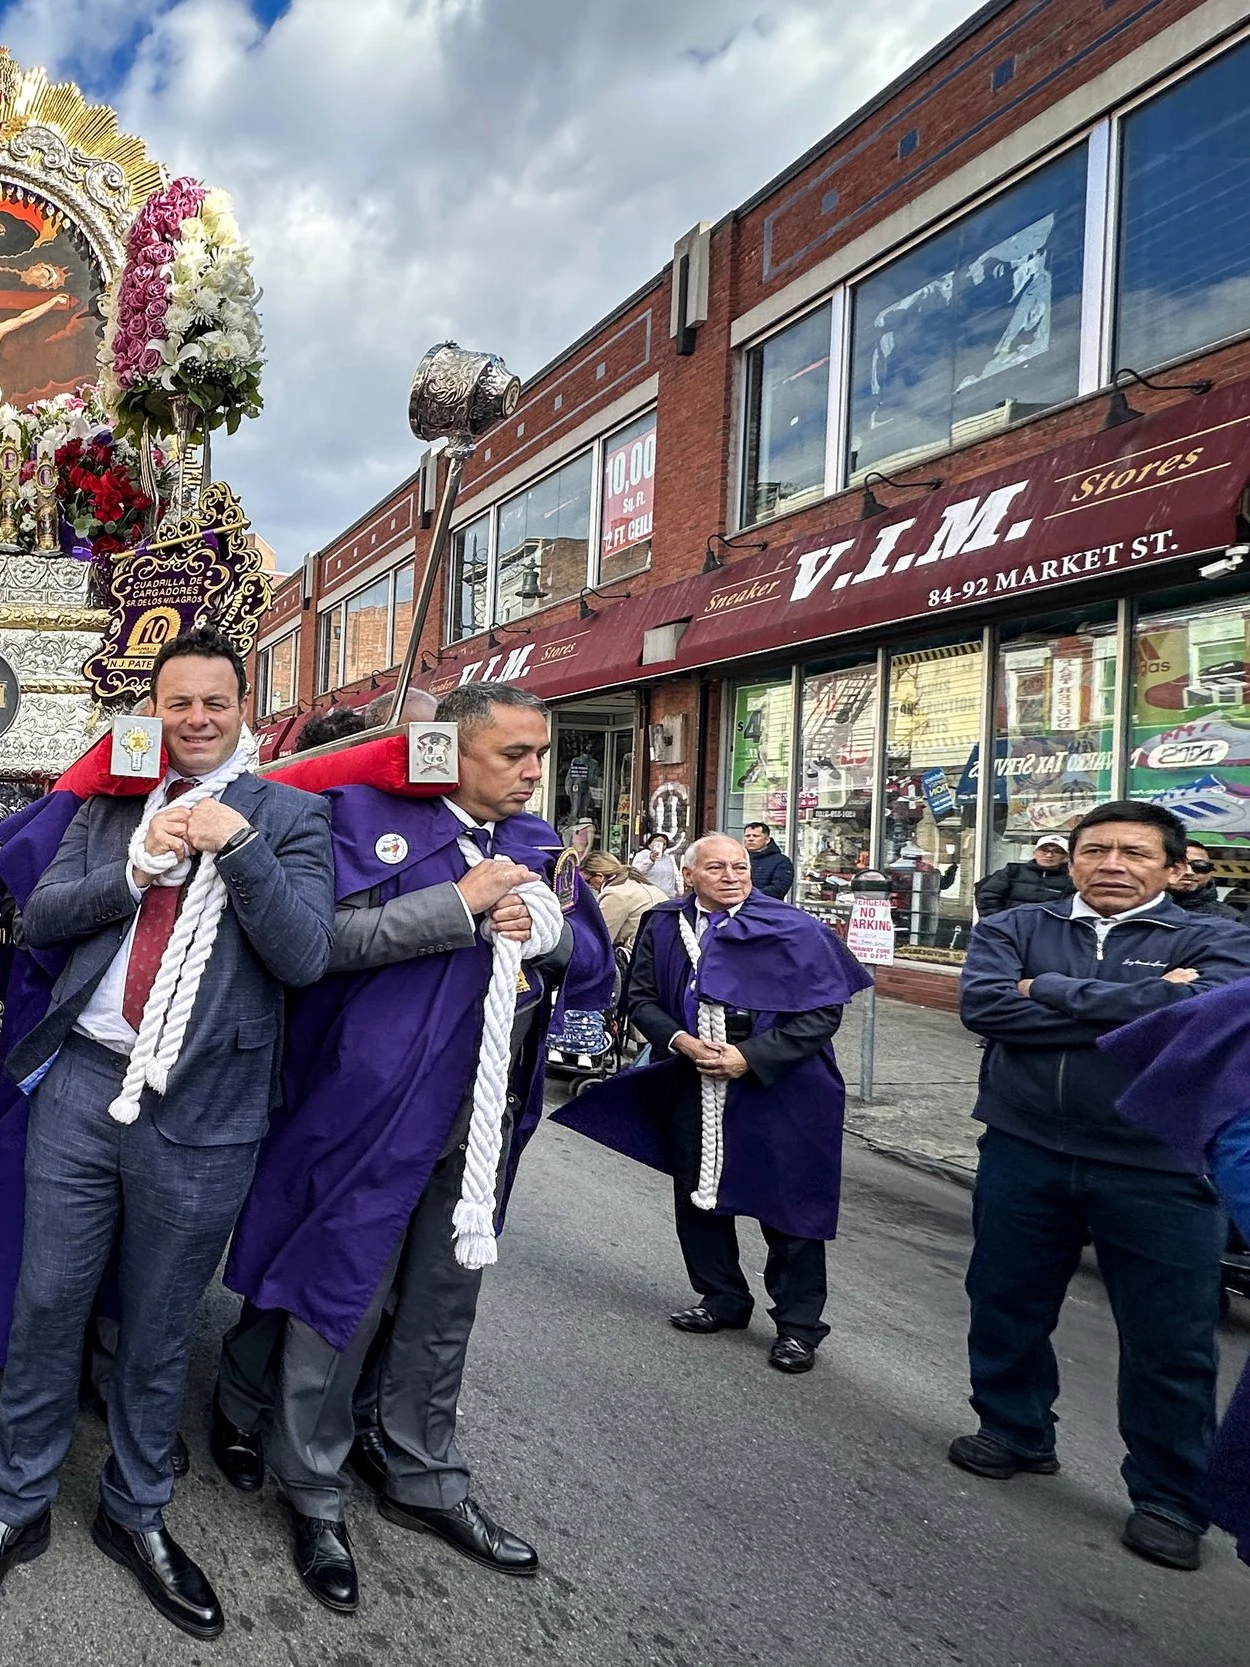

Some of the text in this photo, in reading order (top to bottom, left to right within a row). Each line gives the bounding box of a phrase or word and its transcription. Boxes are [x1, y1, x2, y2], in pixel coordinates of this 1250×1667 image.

[1071, 444, 1203, 503] Stores
[789, 479, 1034, 602] V.I.M.
[928, 529, 1179, 606] 84-92 MARKET ST.
[133, 576, 203, 589] CUADRILLA DE
[132, 586, 199, 599] CARGADORES
[137, 599, 147, 607] DE
[148, 598, 162, 606] LOS
[162, 595, 203, 604] MILAGROS
[704, 580, 781, 613] Sneaker
[144, 618, 167, 644] 10
[541, 642, 576, 661] Stores
[109, 659, 153, 669] N.J. PATE
[859, 907, 876, 918] NO
